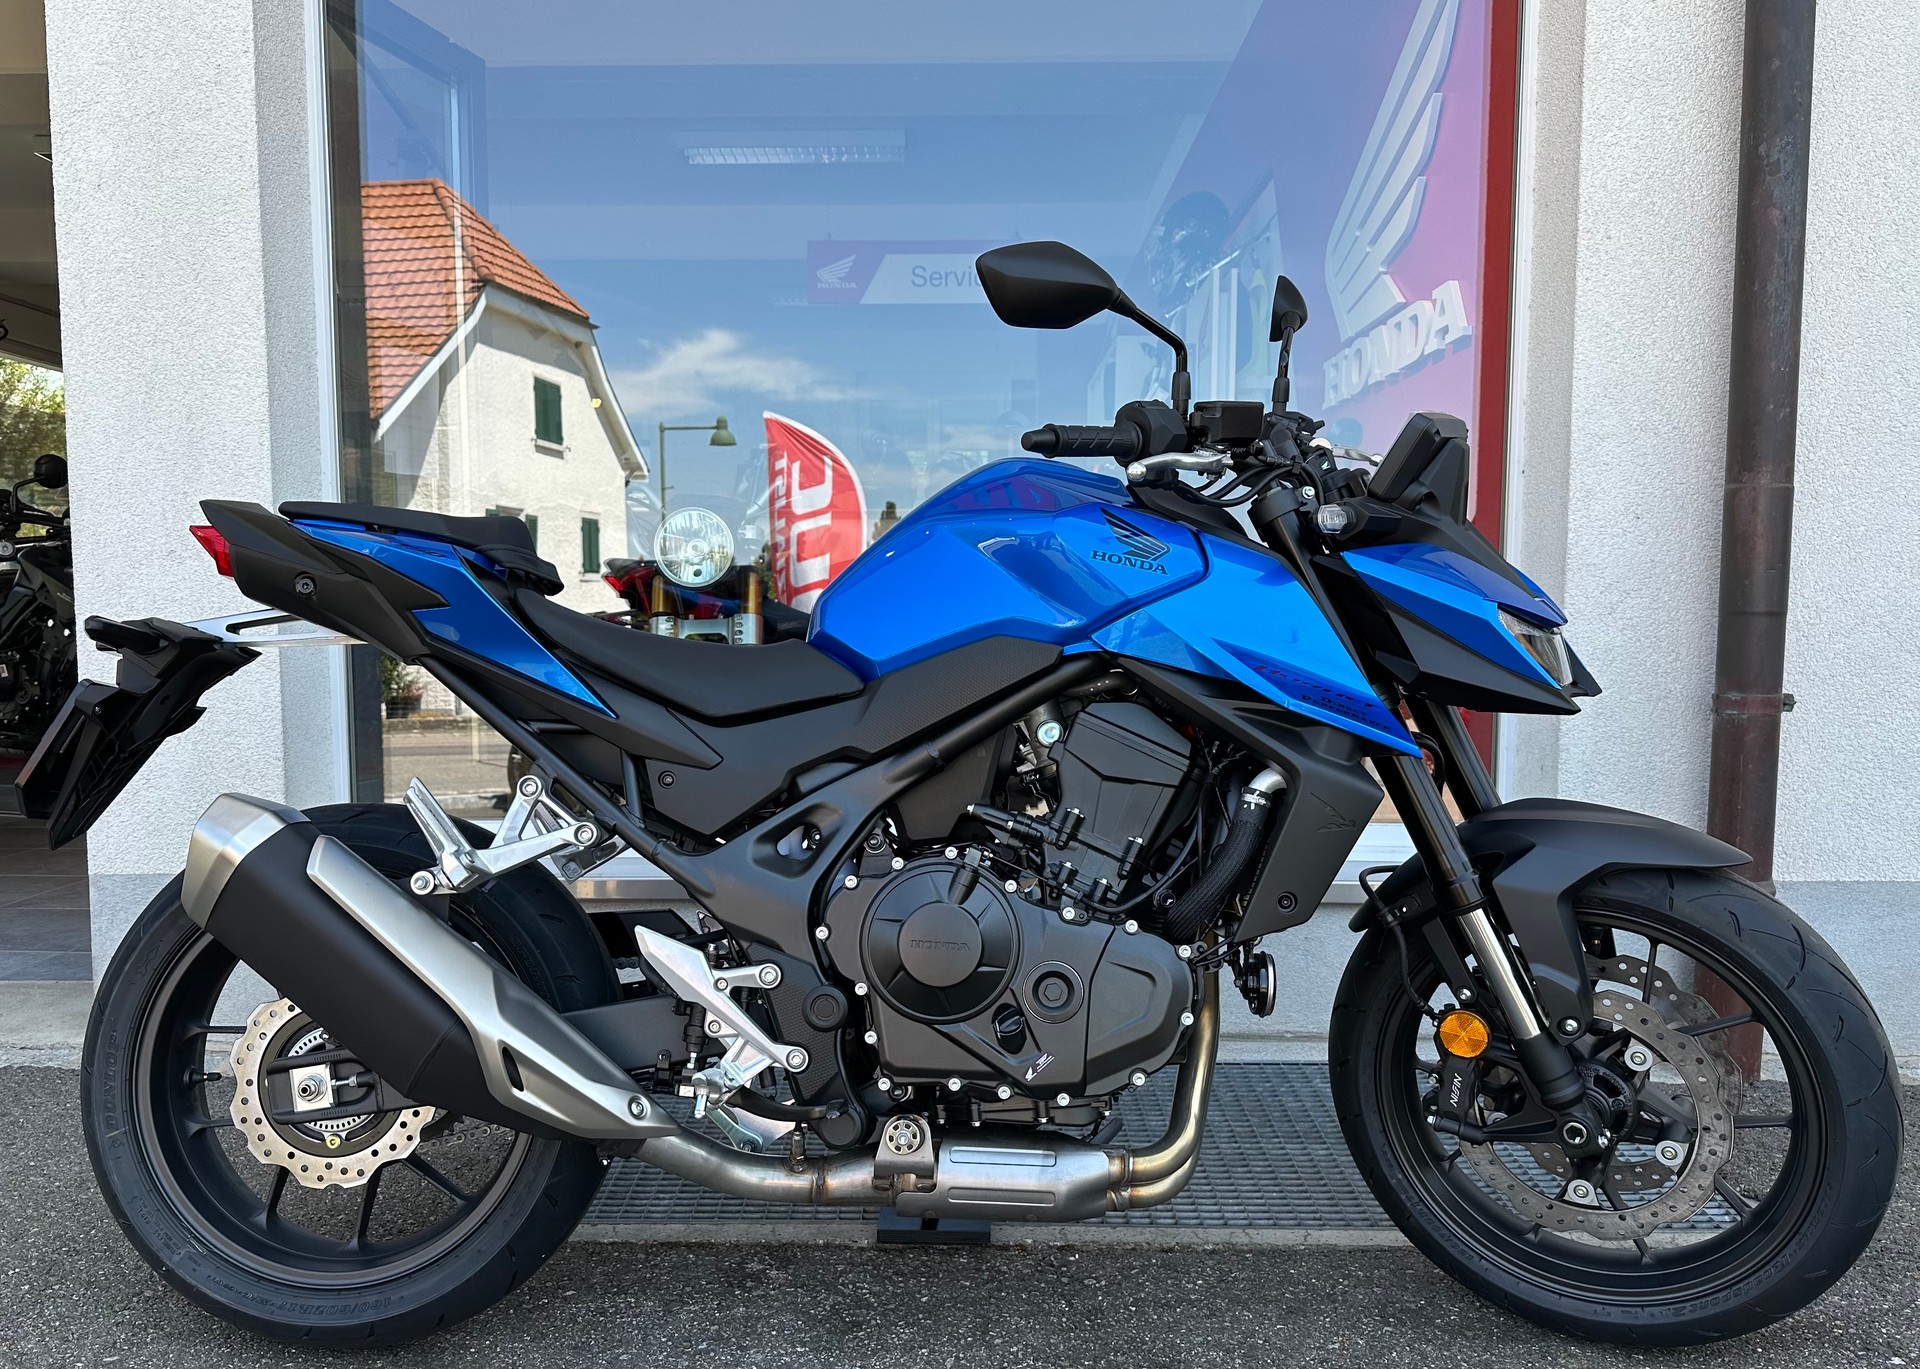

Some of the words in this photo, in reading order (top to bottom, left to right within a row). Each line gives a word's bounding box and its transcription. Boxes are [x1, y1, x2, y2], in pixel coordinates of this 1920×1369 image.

[1322, 280, 1473, 411] HONDA
[1091, 550, 1169, 575] HONDA
[910, 939, 970, 952] HONDA
[103, 1033, 120, 1131] DUNLOP
